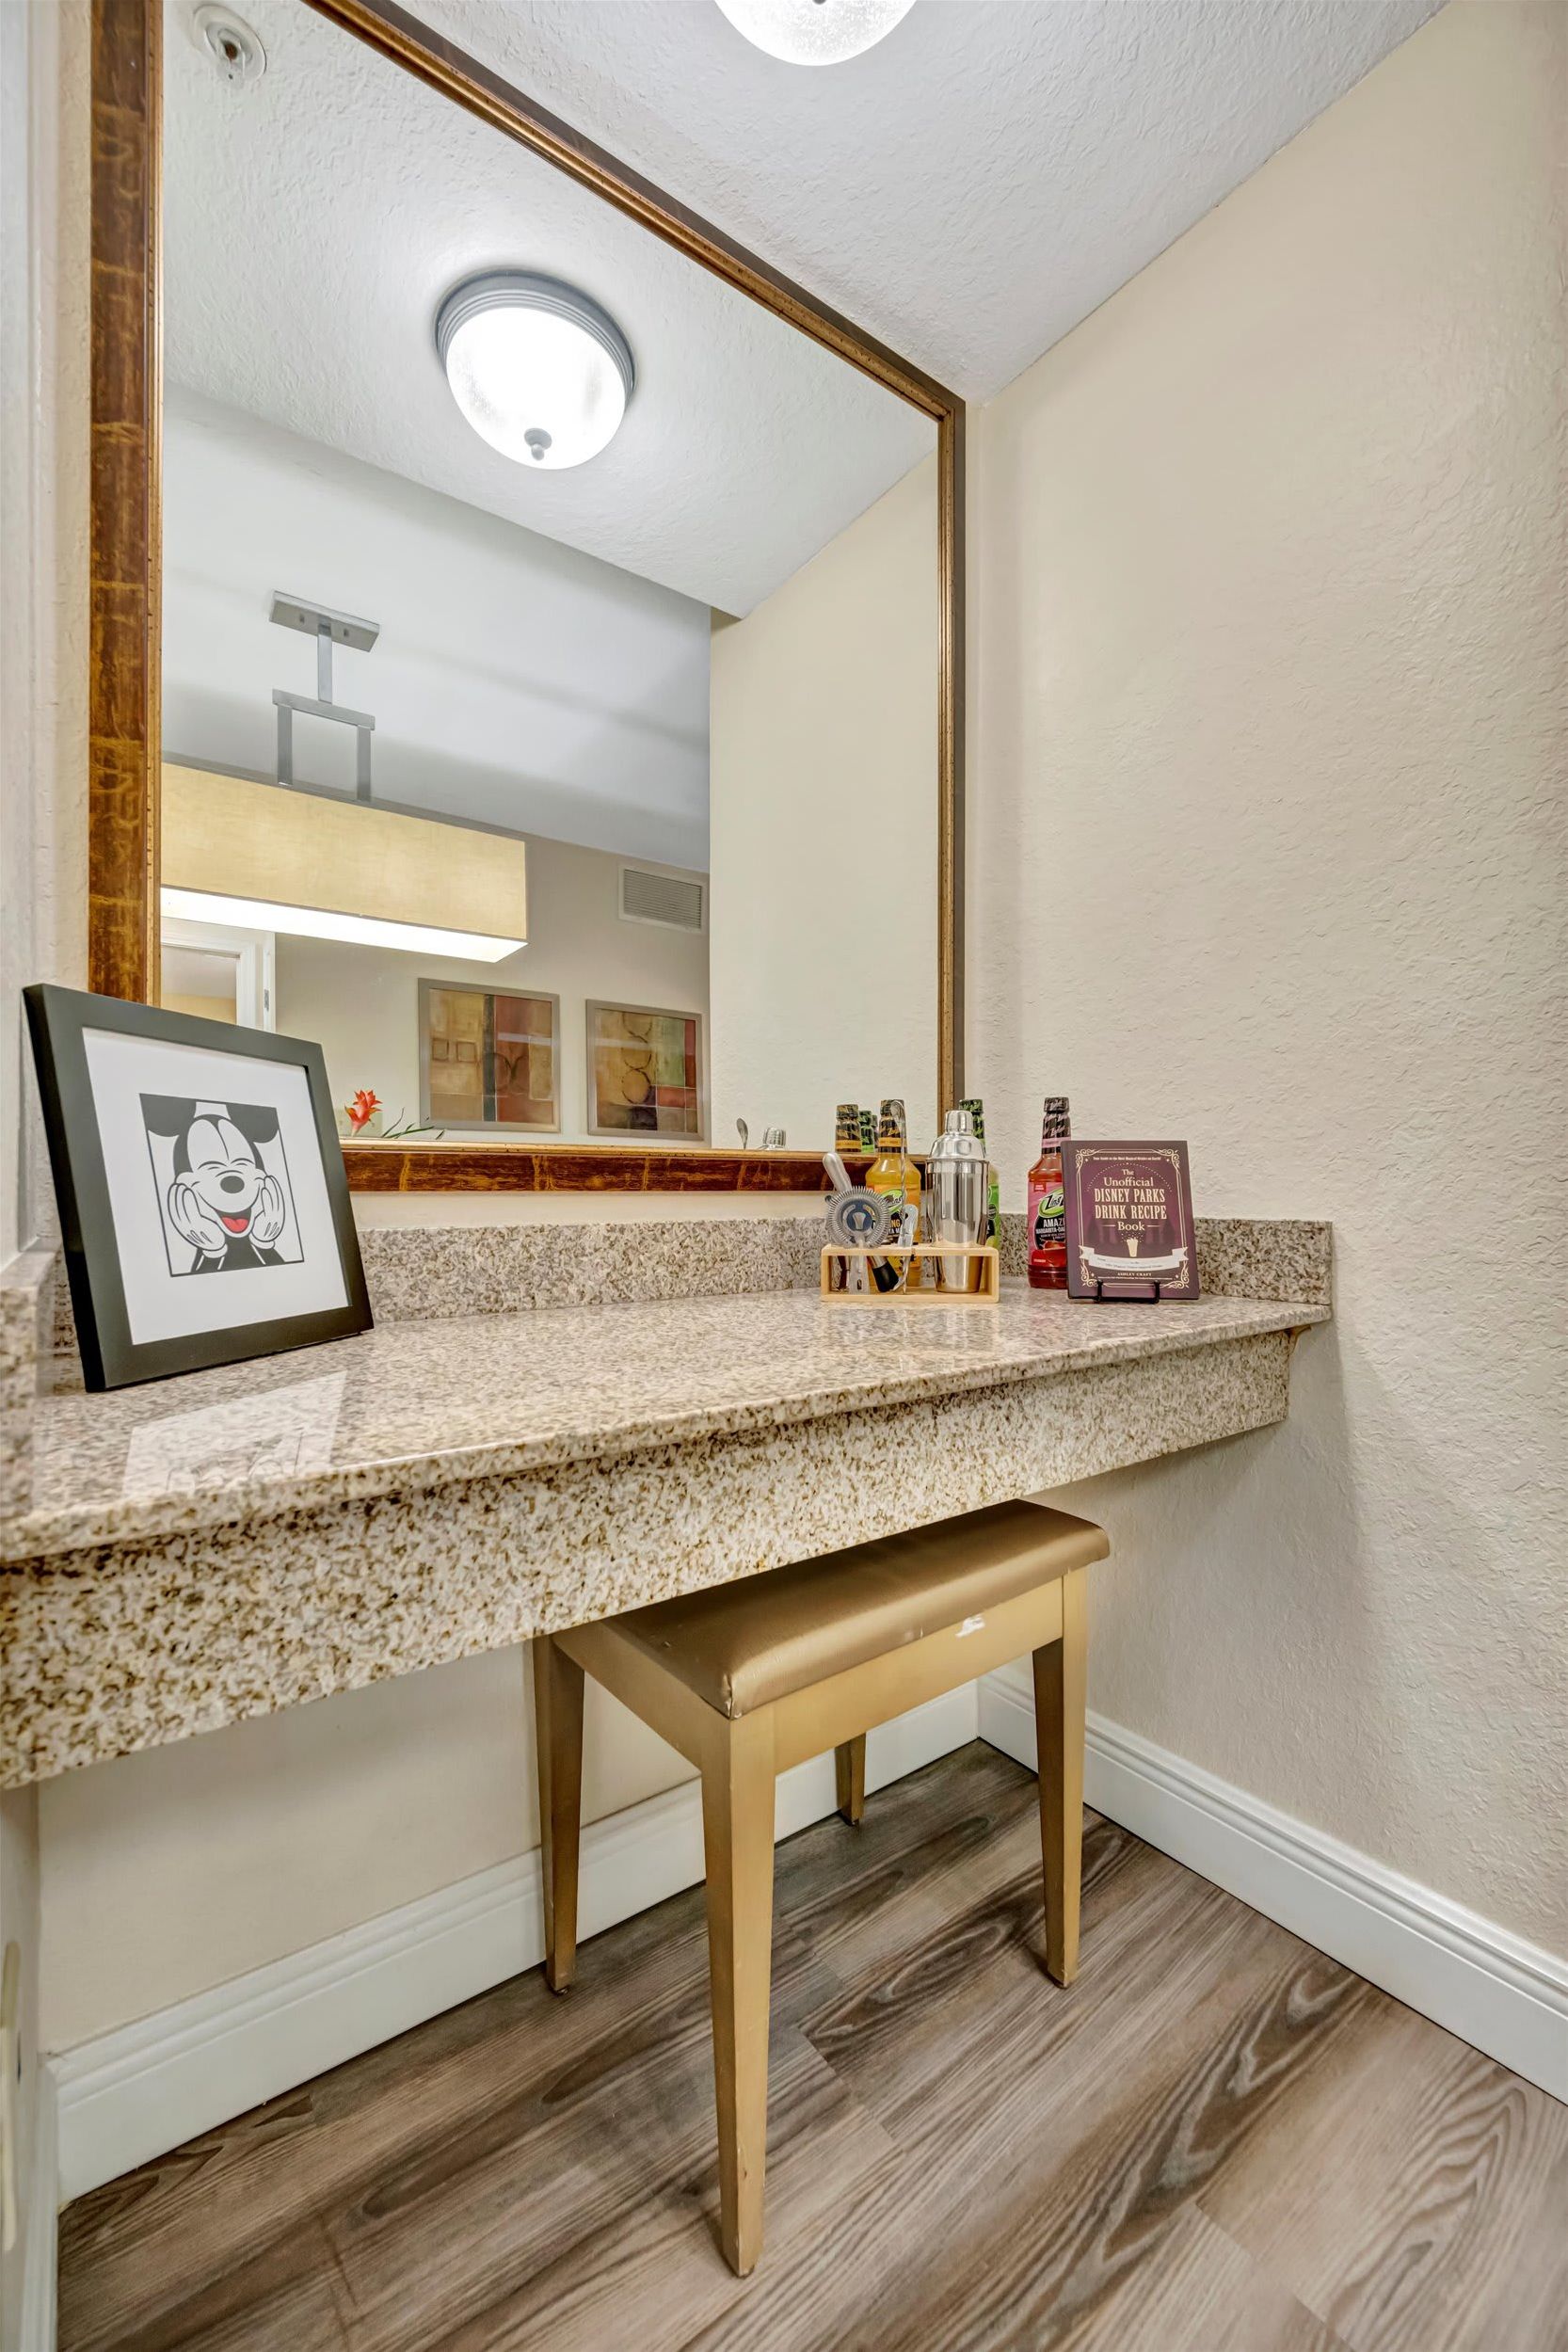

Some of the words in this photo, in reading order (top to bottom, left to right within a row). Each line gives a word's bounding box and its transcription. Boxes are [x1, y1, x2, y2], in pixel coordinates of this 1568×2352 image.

[1103, 1176, 1154, 1187] Unofficial
[1094, 1189, 1129, 1202] DISNEY
[1133, 1189, 1165, 1202] PARKS
[1095, 1205, 1128, 1219] DRINK
[1130, 1205, 1167, 1220] RECIPE
[1117, 1221, 1145, 1231] Book
